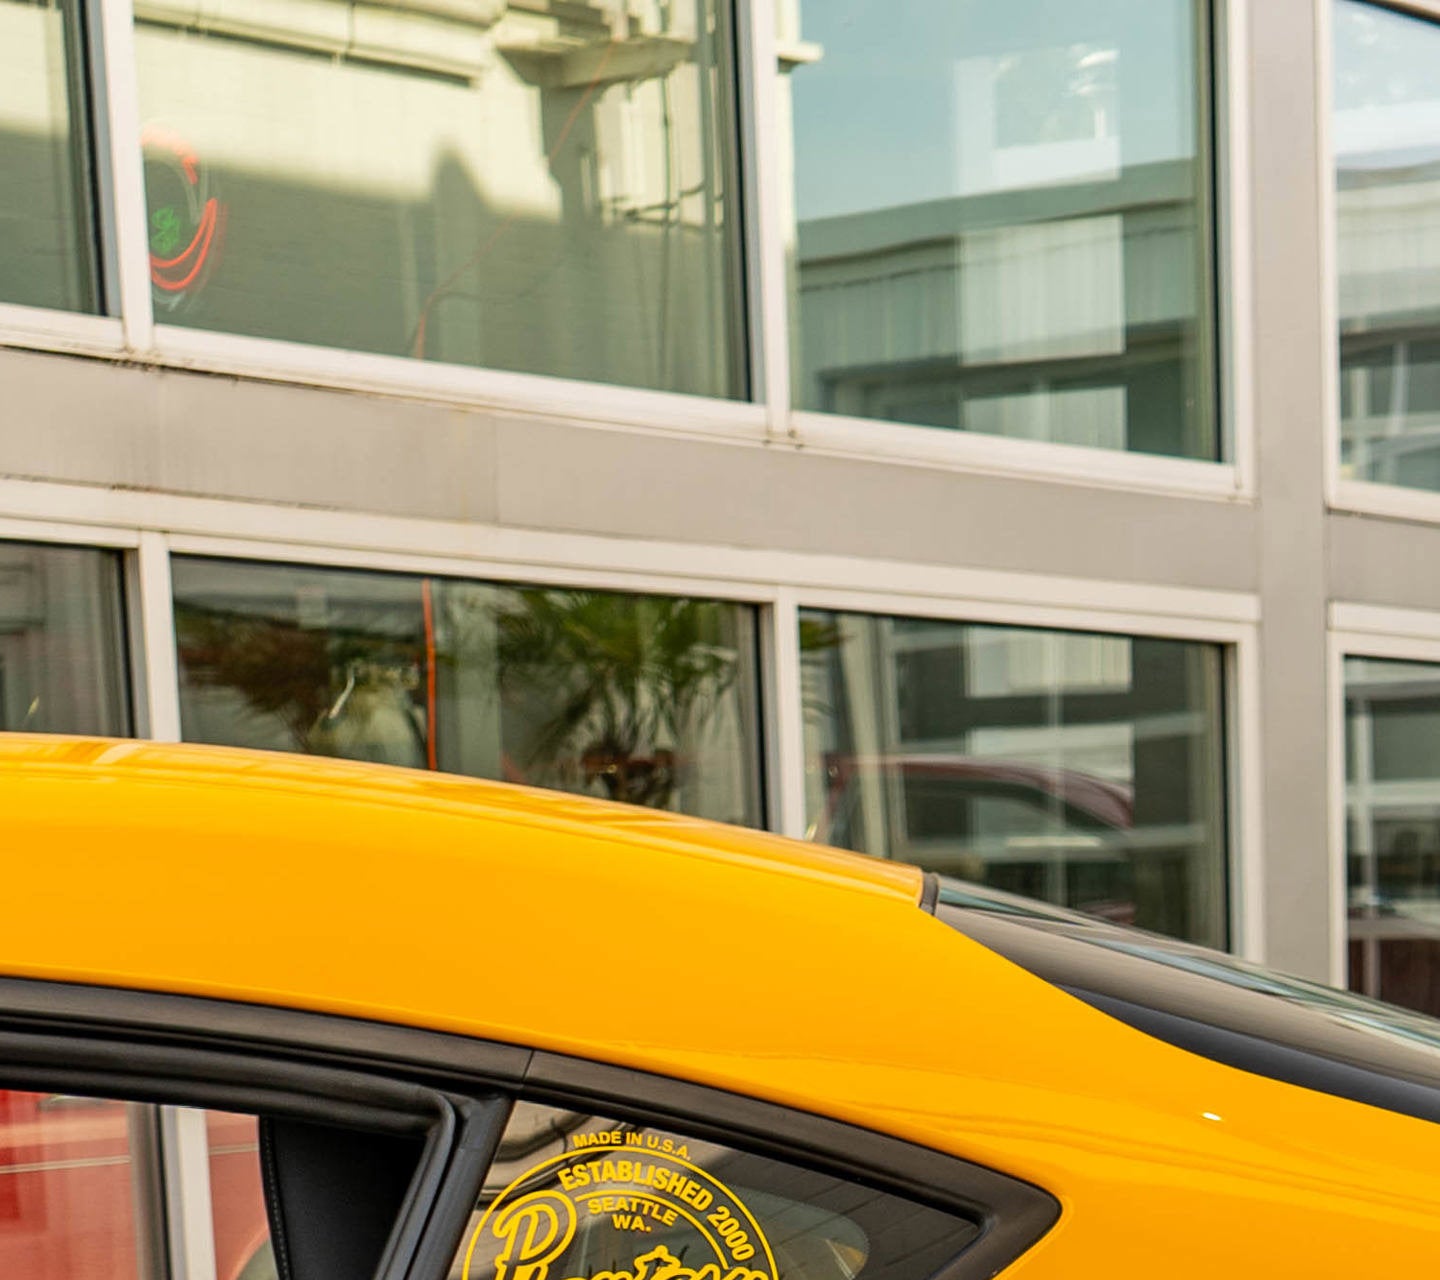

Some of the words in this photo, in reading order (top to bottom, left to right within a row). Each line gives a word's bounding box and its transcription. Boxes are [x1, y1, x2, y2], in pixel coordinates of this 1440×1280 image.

[572, 1131, 623, 1148] MADE
[626, 1132, 643, 1147] IN
[647, 1134, 692, 1161] U.S.A.
[557, 1160, 715, 1212] ESTABLISHED
[707, 1205, 756, 1262] 2000
[587, 1196, 679, 1227] SEATTLE
[611, 1214, 652, 1233] WA.
